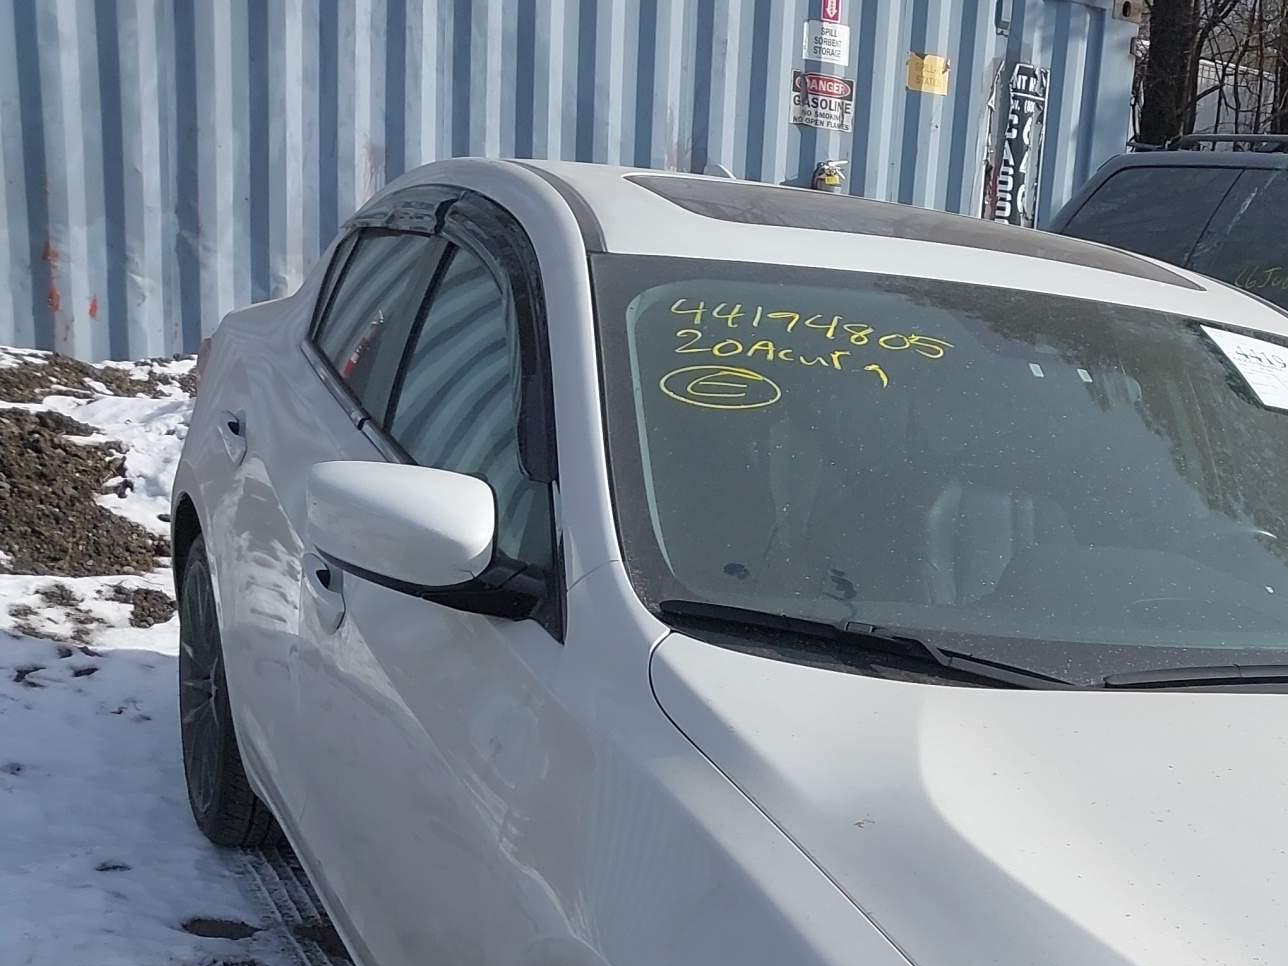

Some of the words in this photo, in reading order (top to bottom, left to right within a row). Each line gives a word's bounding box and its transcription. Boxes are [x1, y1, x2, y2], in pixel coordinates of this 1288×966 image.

[820, 27, 838, 38] SPILL
[813, 46, 841, 57] STORAGE
[793, 94, 852, 114] GASOLINE
[814, 110, 842, 122] SMOKIN
[805, 117, 825, 127] OPEN
[671, 298, 955, 359] 44194805
